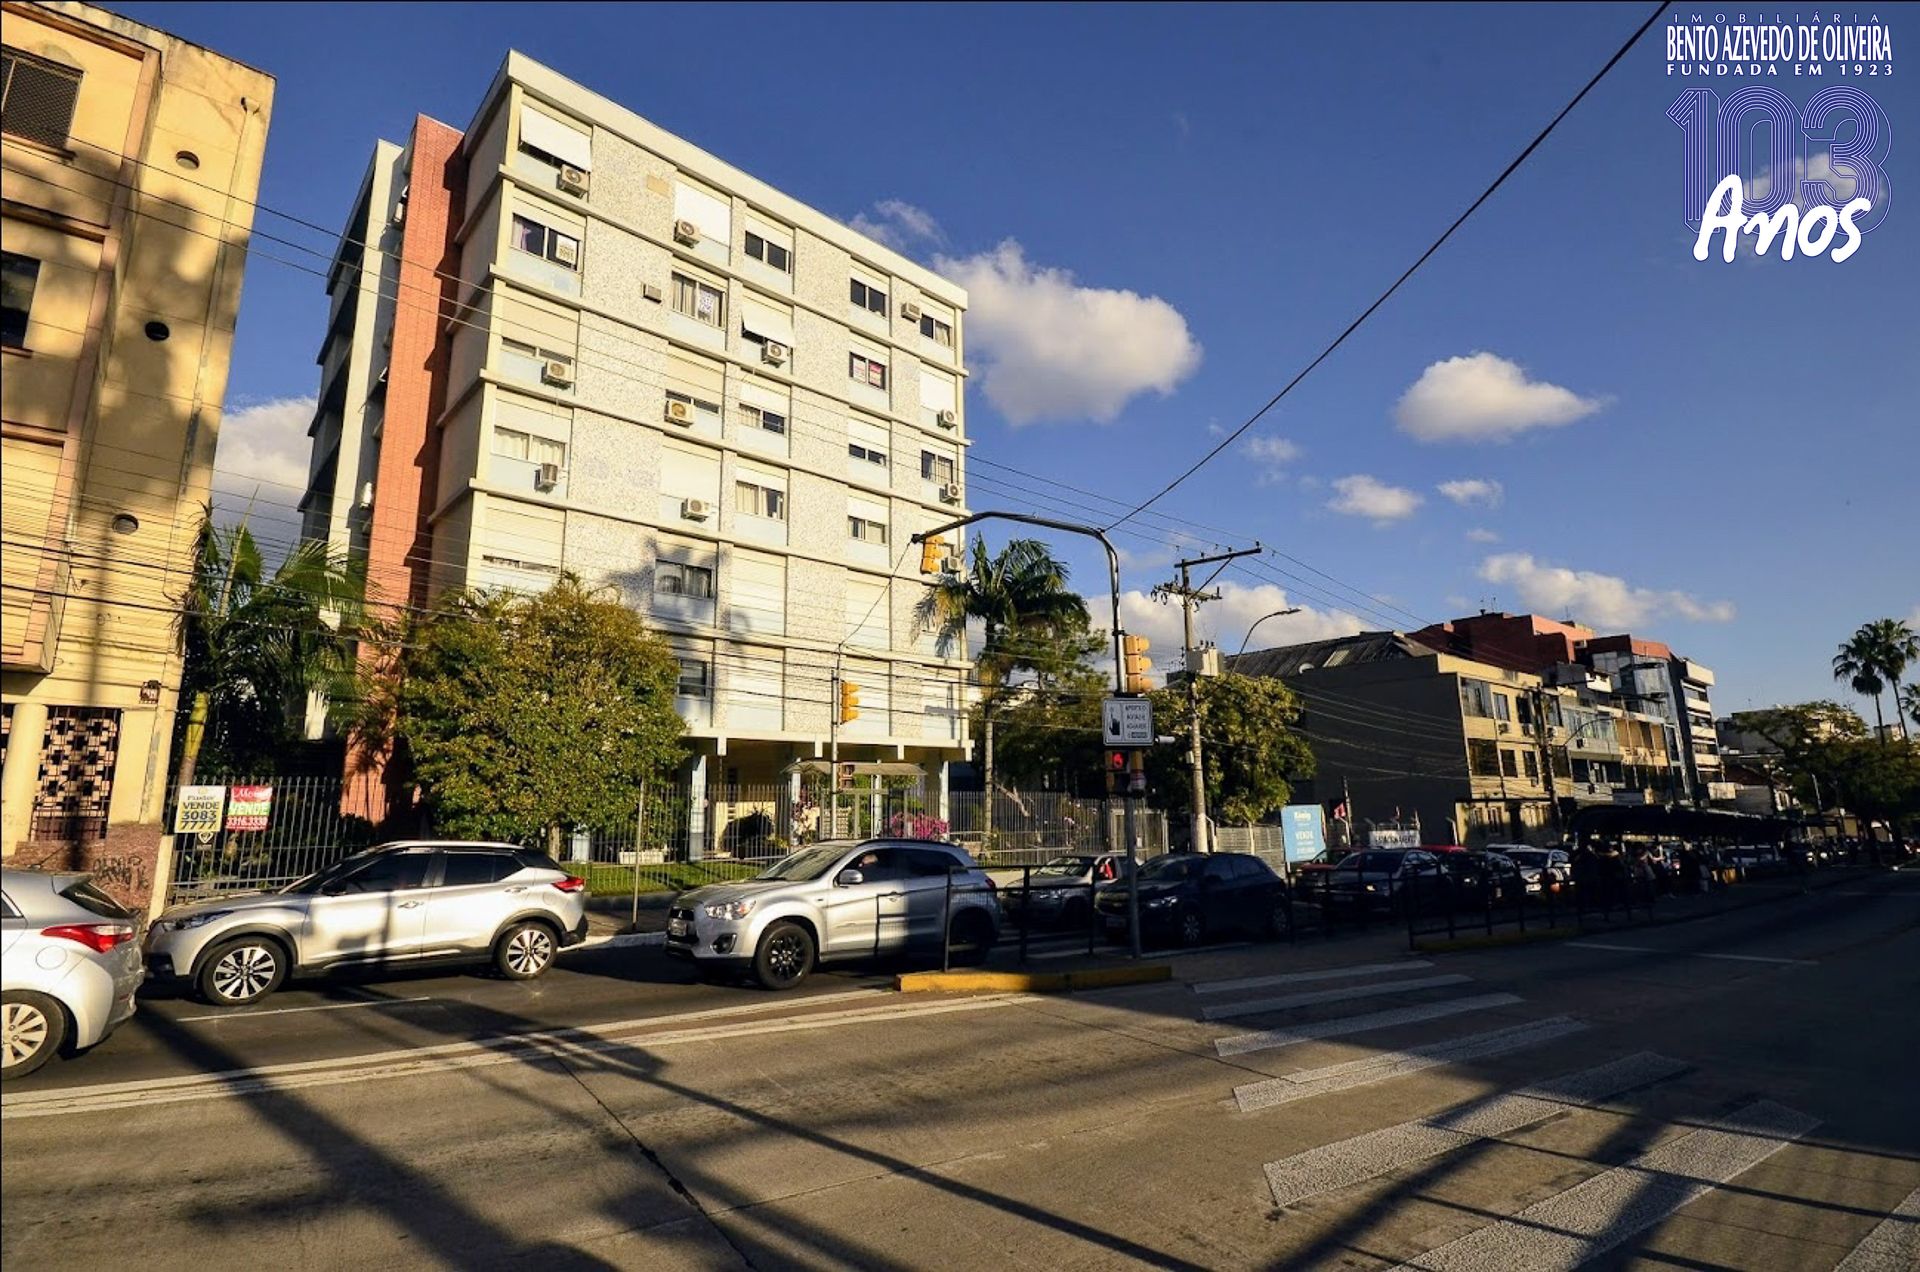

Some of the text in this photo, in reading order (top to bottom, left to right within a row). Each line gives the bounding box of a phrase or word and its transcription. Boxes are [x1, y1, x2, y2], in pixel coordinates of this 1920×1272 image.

[183, 801, 220, 810] VENDE
[181, 810, 217, 820] 3083
[180, 820, 217, 830] 7777
